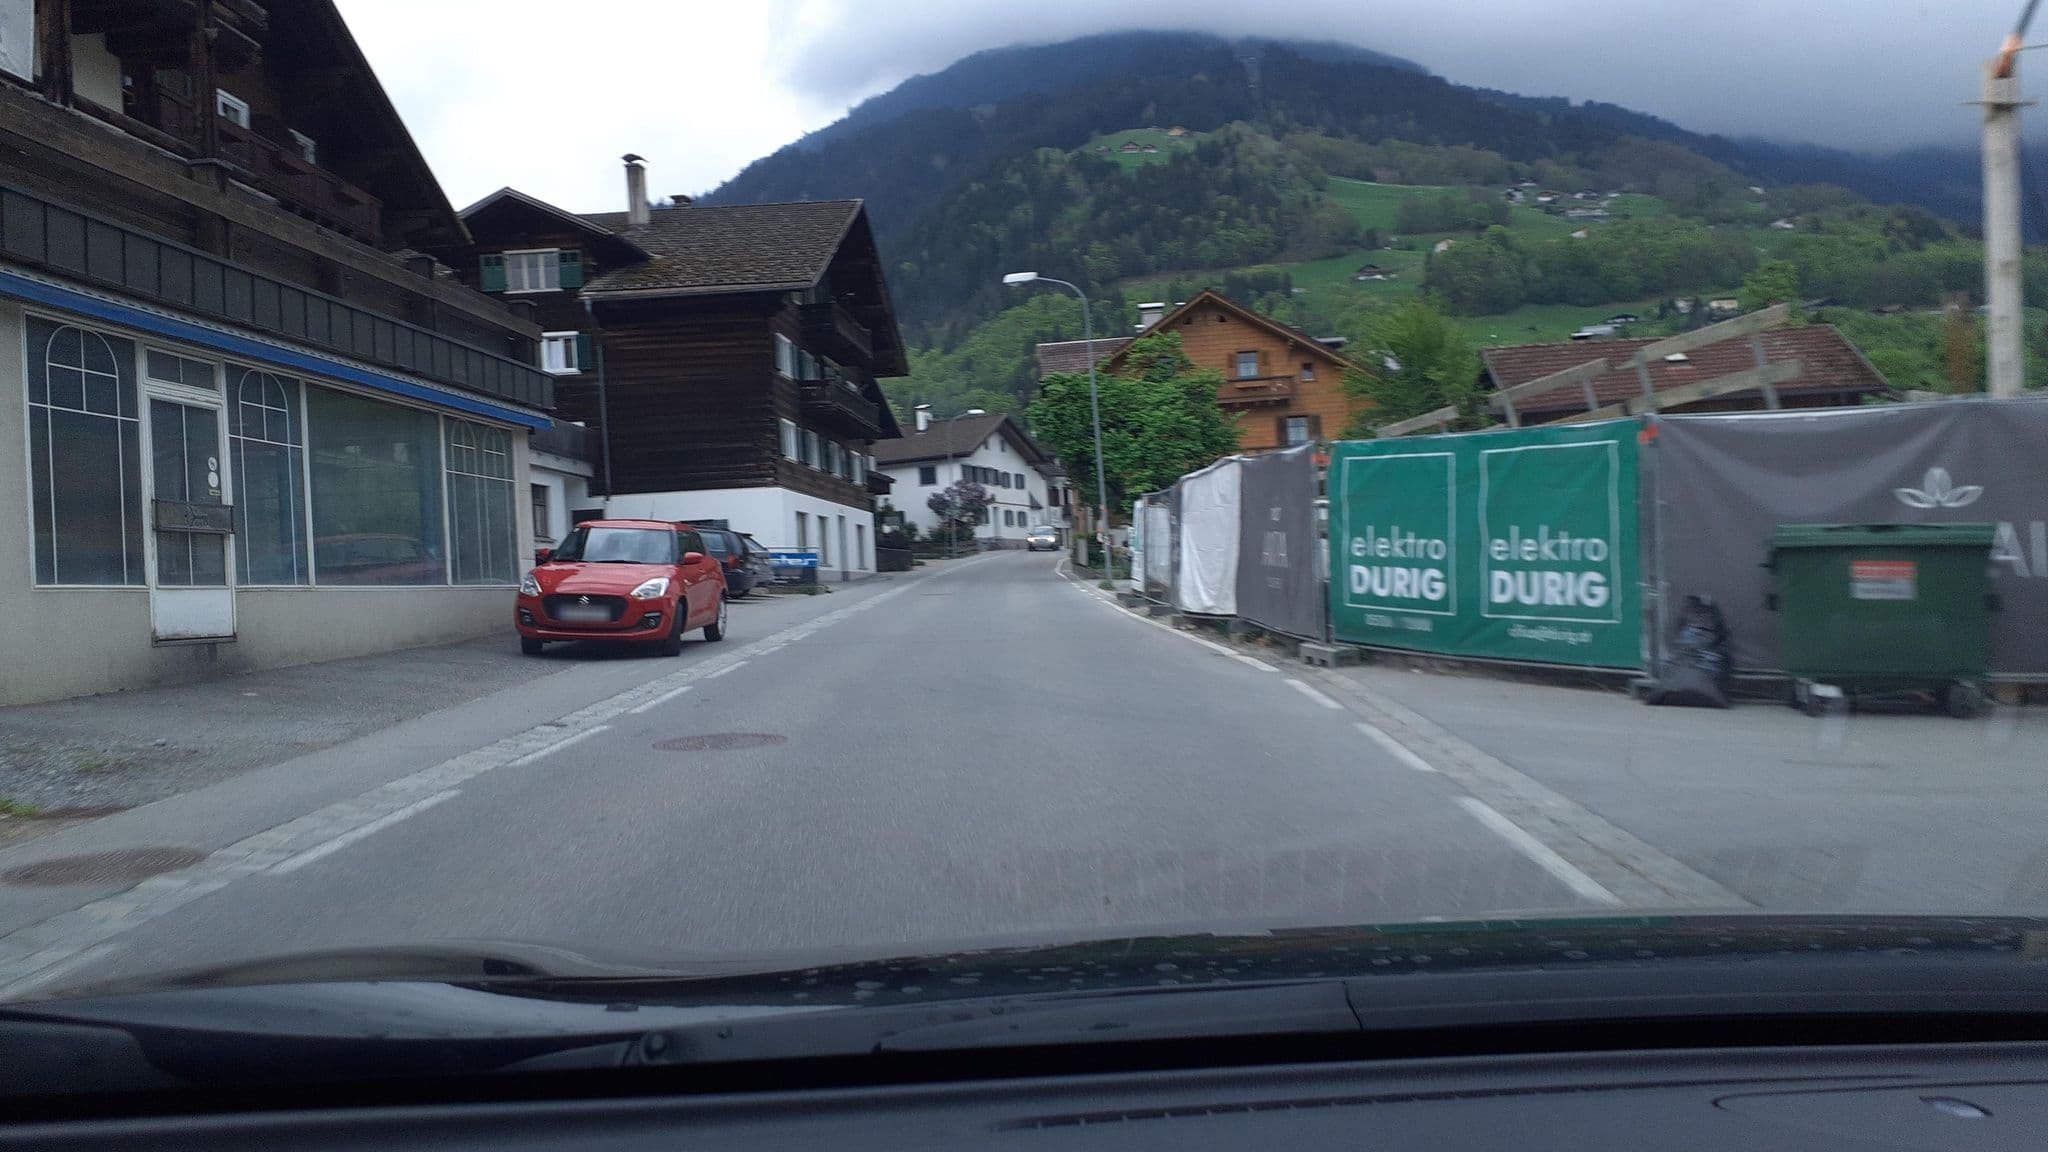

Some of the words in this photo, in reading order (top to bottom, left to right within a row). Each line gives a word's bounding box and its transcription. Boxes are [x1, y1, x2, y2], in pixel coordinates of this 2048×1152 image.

[1350, 524, 1447, 560] elektro
[1489, 524, 1609, 562] elektro
[1349, 564, 1448, 601] DURIG
[1489, 569, 1610, 608] DURIG
